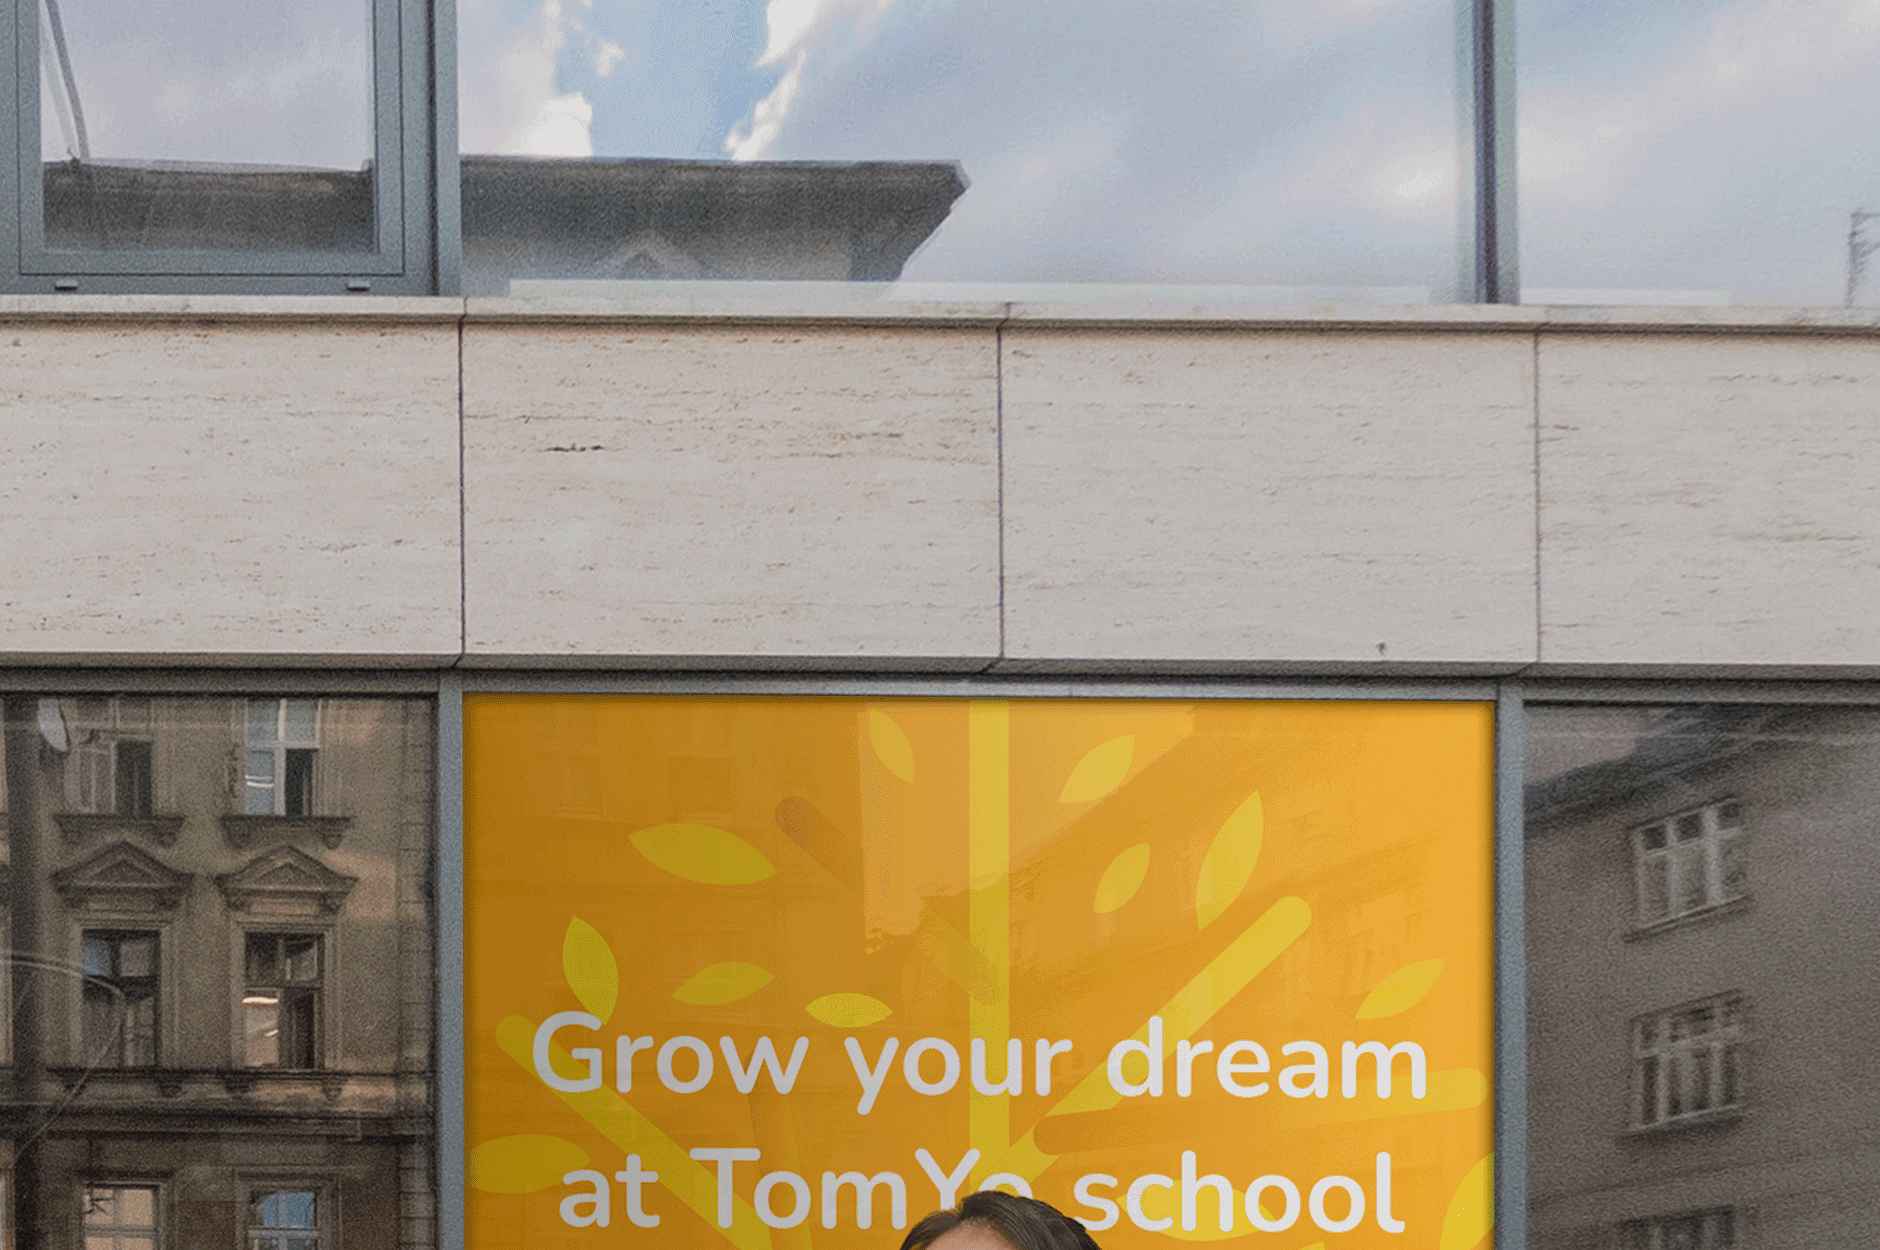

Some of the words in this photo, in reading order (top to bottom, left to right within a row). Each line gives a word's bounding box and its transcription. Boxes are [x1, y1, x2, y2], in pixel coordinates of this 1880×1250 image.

[532, 1010, 810, 1095] Grow
[844, 1036, 1074, 1116] your
[1106, 1015, 1427, 1100] dream
[559, 1153, 661, 1229] at
[1072, 1149, 1406, 1235] school
